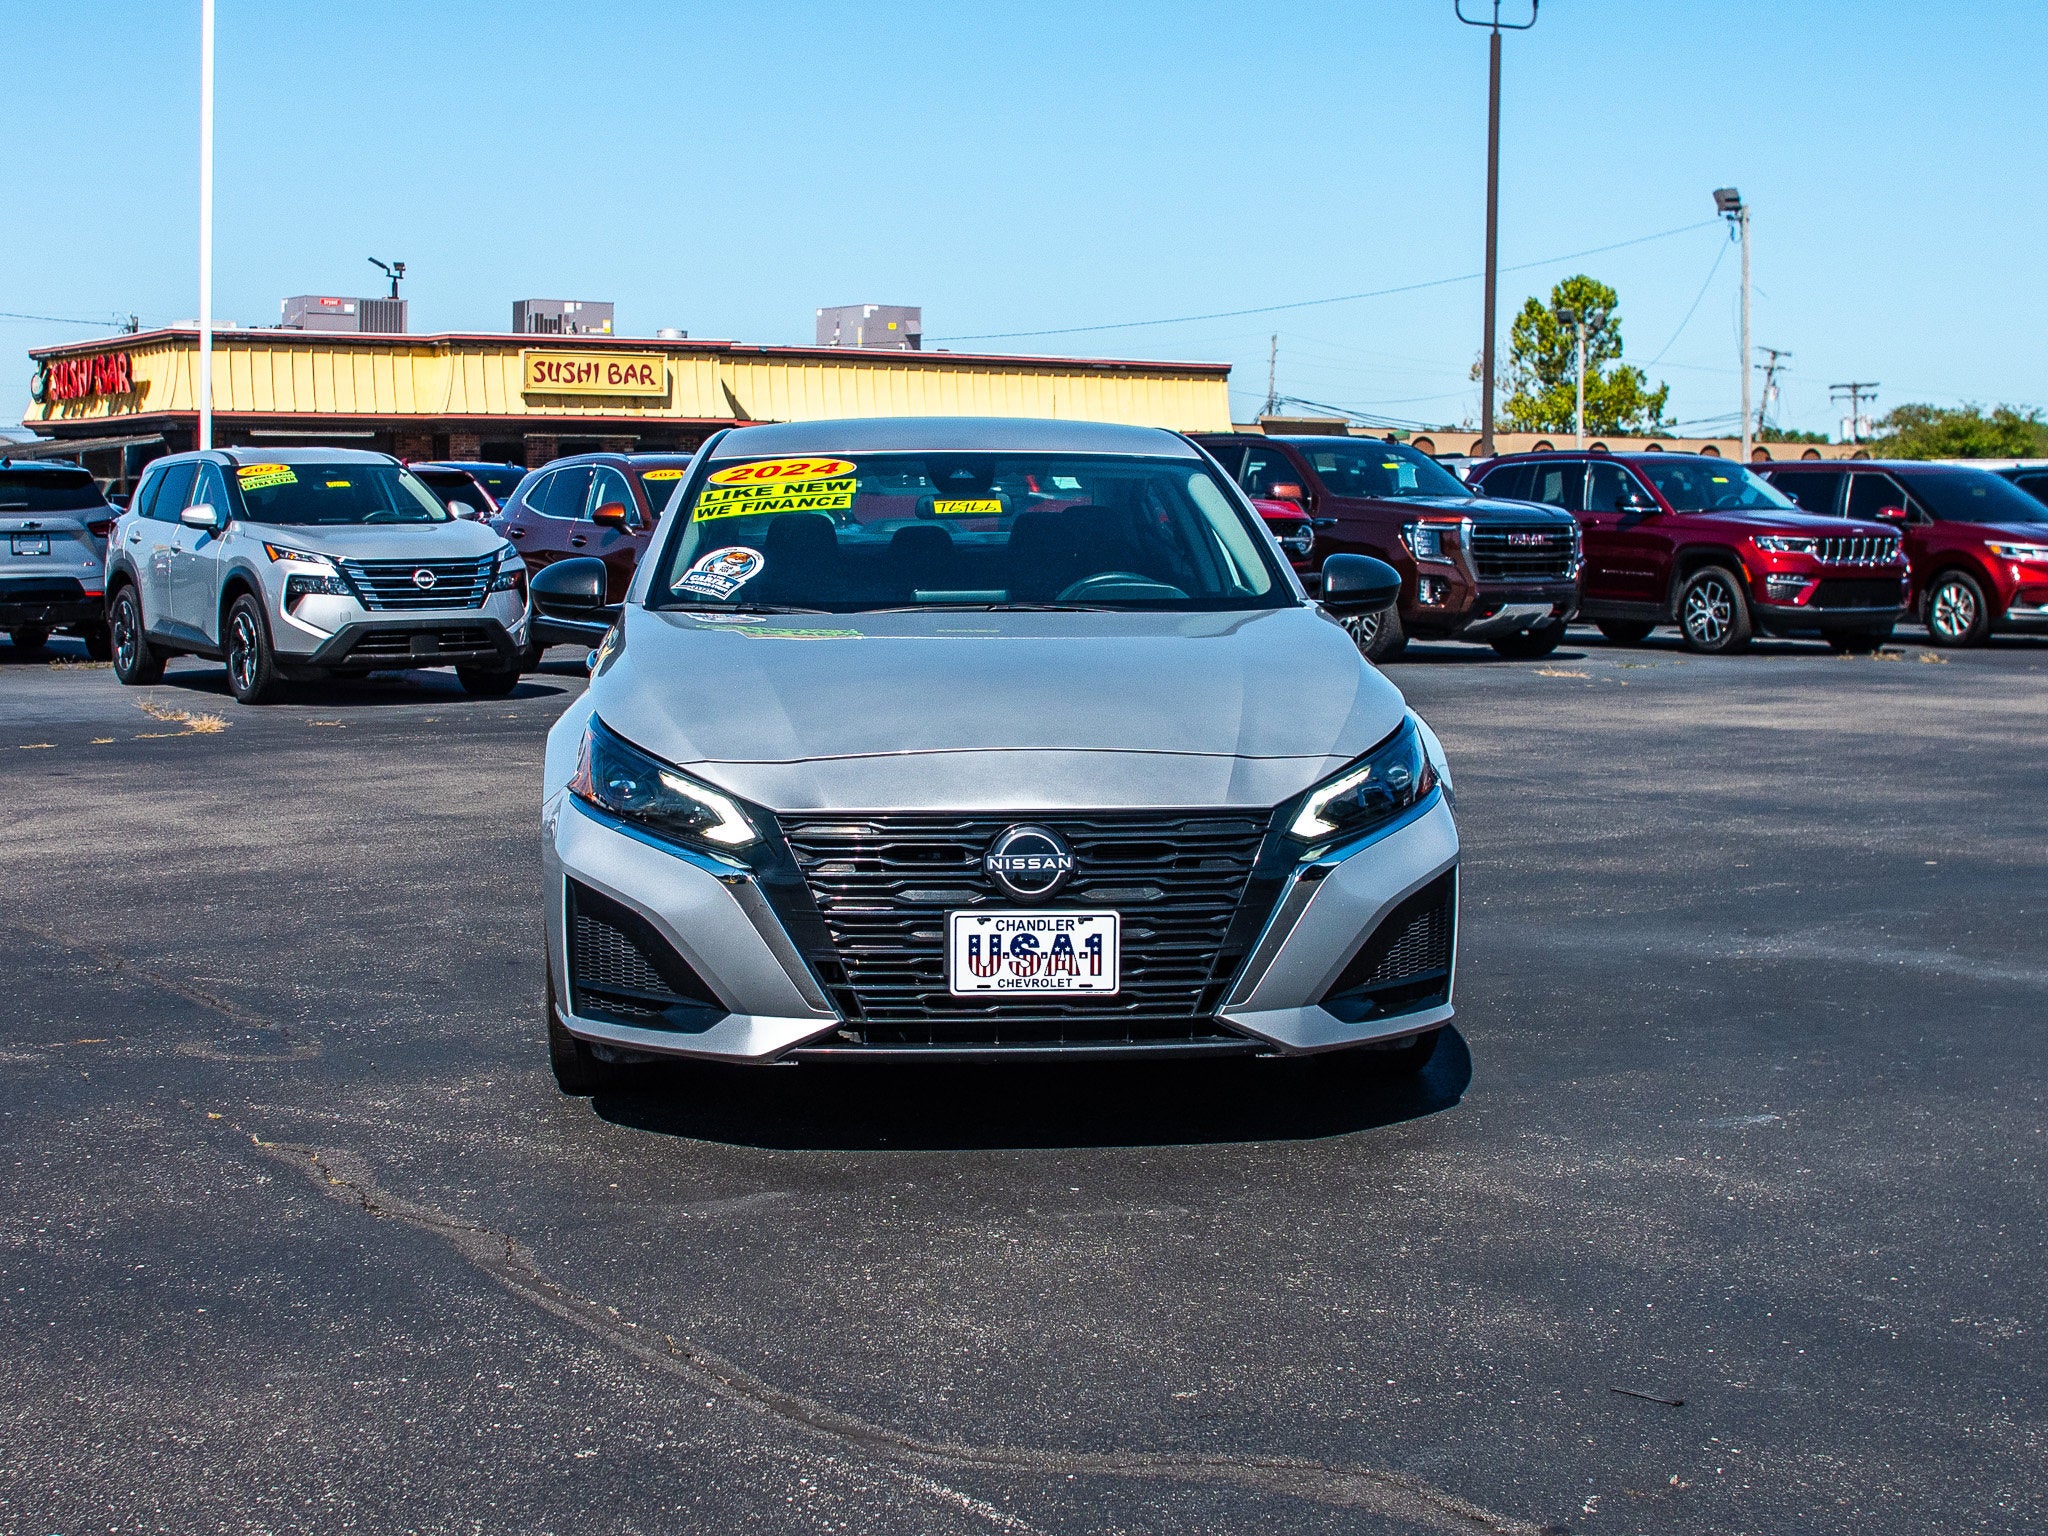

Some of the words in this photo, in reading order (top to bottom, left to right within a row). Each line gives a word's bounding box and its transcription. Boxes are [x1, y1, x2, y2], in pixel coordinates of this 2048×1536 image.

[49, 357, 94, 401] SUSHI
[95, 351, 131, 396] BAR
[532, 360, 600, 384] SUSHI
[607, 362, 657, 386] BAR
[244, 465, 284, 475] 2024
[723, 461, 842, 483] 2024
[704, 486, 774, 503] LIKE
[783, 480, 853, 495] NEW
[697, 504, 733, 518] WE
[740, 495, 848, 513] FINANCE
[989, 857, 1072, 870] NISSAN
[995, 919, 1075, 932] CHANDLER
[997, 978, 1073, 988] CHEVROLET
